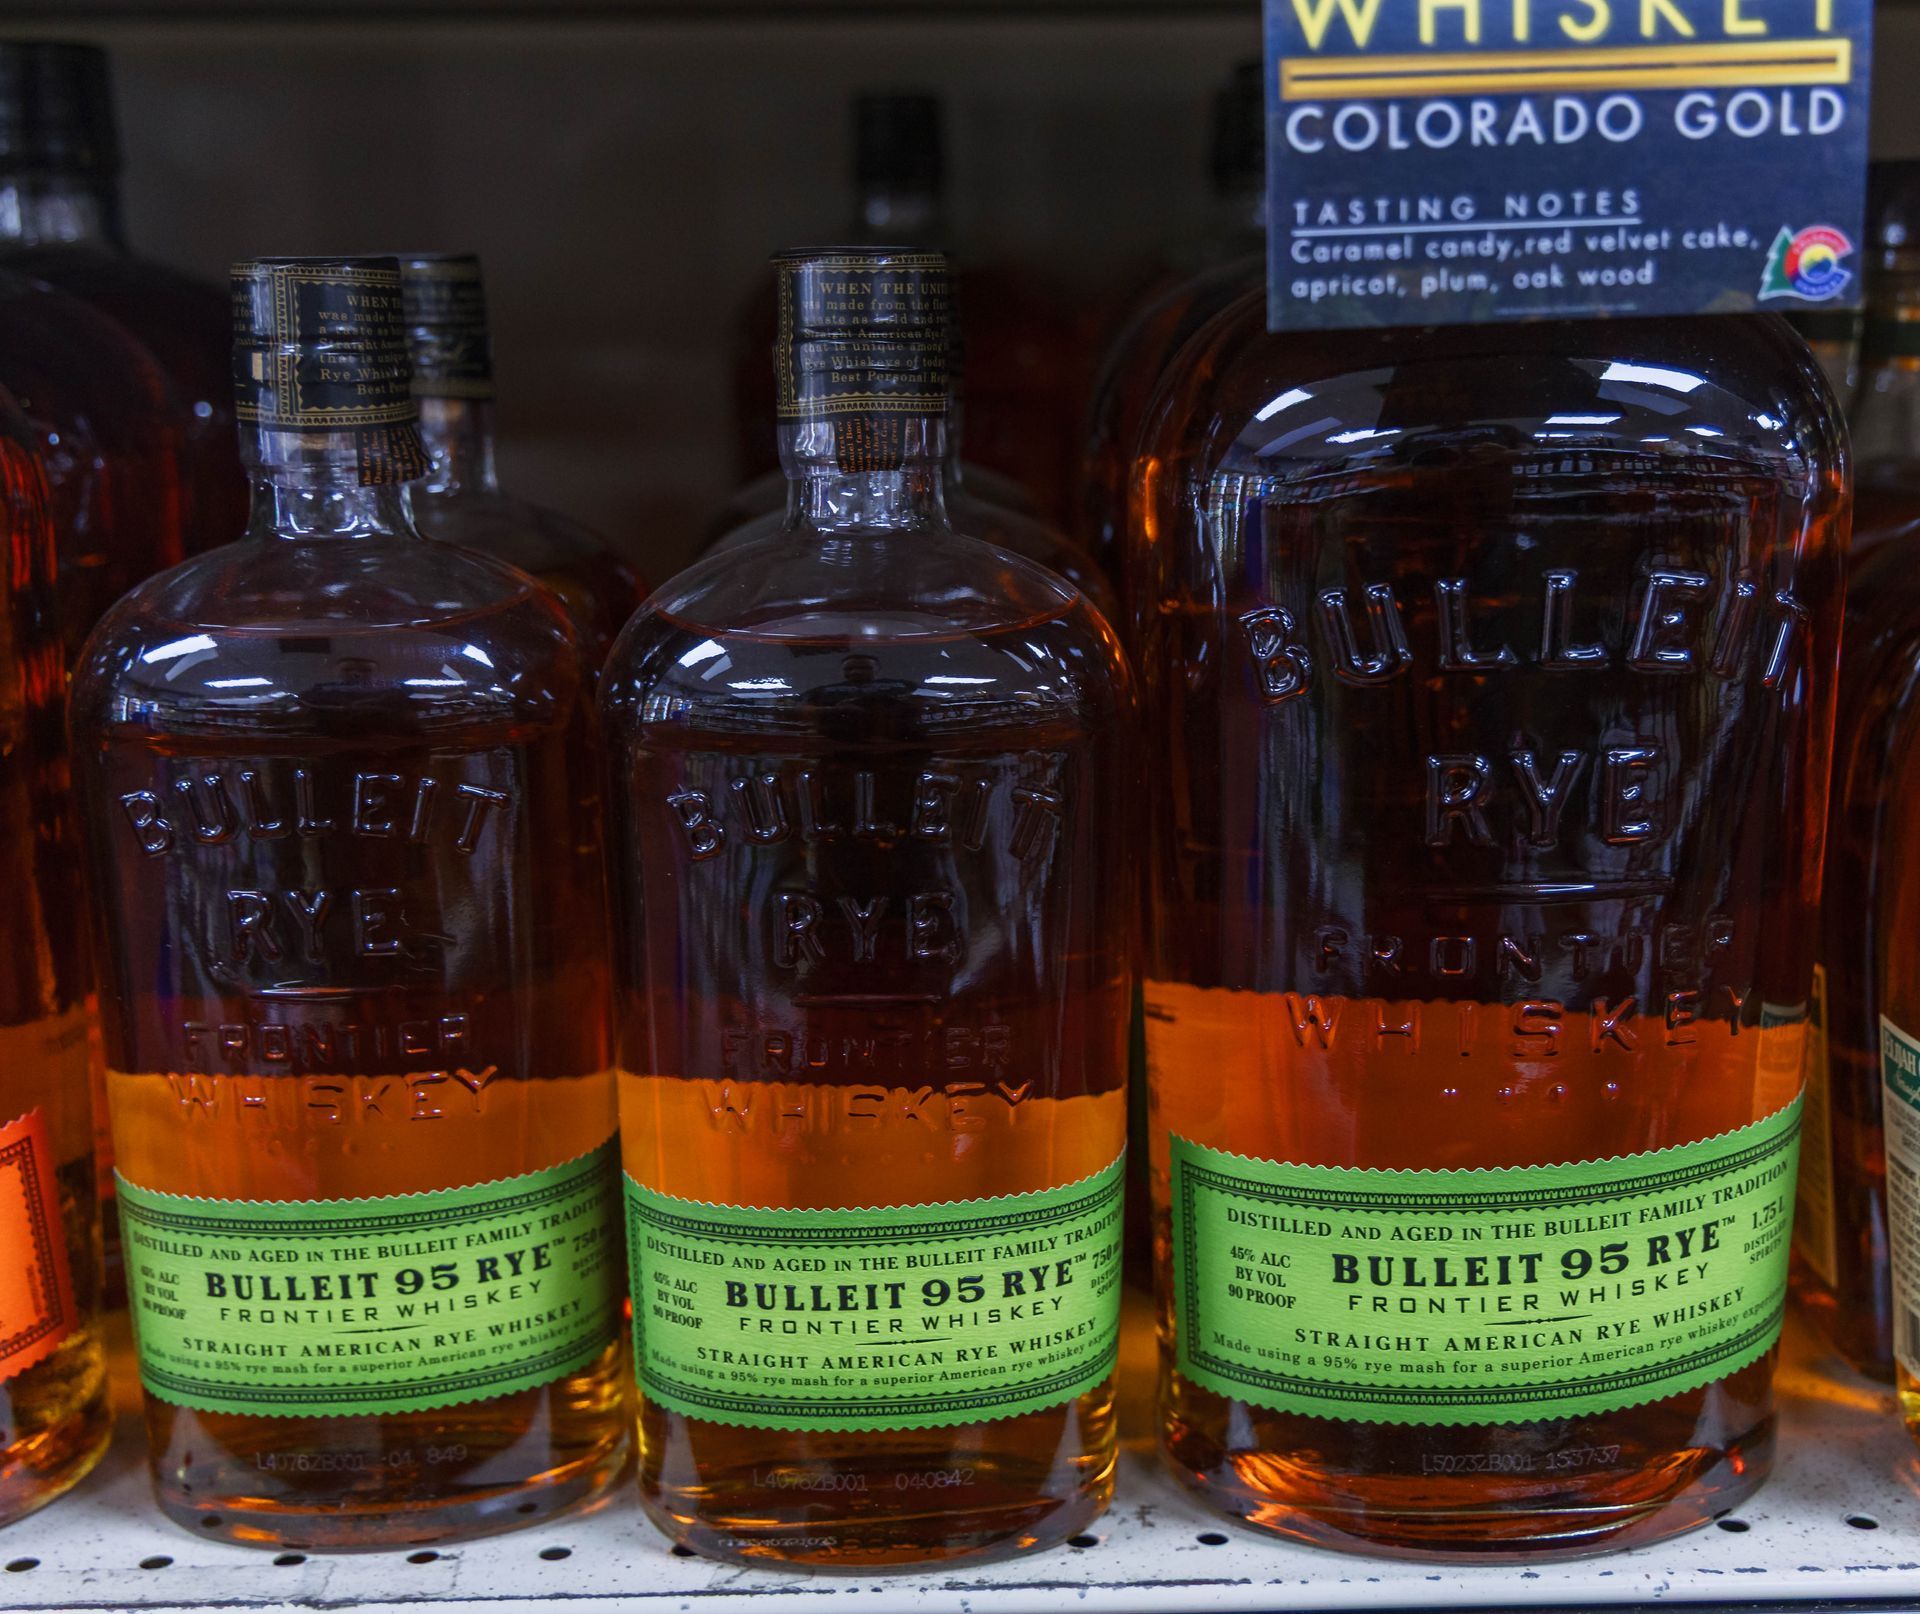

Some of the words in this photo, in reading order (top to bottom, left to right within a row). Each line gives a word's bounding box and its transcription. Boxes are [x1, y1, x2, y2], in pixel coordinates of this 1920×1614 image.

[1285, 95, 1644, 154] COLORADO
[1674, 88, 1846, 140] GOLD
[1294, 196, 1475, 226] TASTING
[1505, 189, 1639, 218] NOTES
[1291, 234, 1412, 264] Caramel
[1585, 226, 1670, 252] velvet
[820, 283, 872, 295] WHEN
[881, 282, 915, 295] THE
[1291, 273, 1407, 303] apricot,
[1513, 262, 1565, 290] oak
[1578, 258, 1656, 286] wood
[346, 295, 389, 308] WHEN
[827, 298, 865, 311] made
[871, 298, 907, 311] from
[320, 368, 352, 382] Rye
[357, 383, 385, 396] Best
[831, 371, 861, 384] Best
[867, 370, 928, 383] Personal
[1237, 567, 1813, 703] BULLEIT
[119, 767, 512, 857] BULLEIT
[665, 769, 1064, 861] BULLEIT
[1423, 744, 1661, 848] RYE
[227, 887, 401, 964] RYE
[772, 892, 964, 969] RYE
[1285, 985, 1751, 1058] WHISKEY
[700, 1078, 1035, 1135] WHISKEY
[1227, 1207, 1332, 1237] DISTILLED
[1341, 1225, 1382, 1241] AND
[1390, 1226, 1453, 1242] AGED
[1462, 1227, 1483, 1241] IN
[1491, 1223, 1536, 1241] THE
[1544, 1211, 1632, 1237] BULLEIT
[1639, 1195, 1707, 1224] FAMILY
[1712, 1159, 1789, 1205] TRADITION
[1751, 1201, 1777, 1230] 1.75
[133, 1231, 203, 1258] DISTILLED
[210, 1249, 241, 1262] AND
[248, 1249, 299, 1263] AGED
[306, 1250, 324, 1262] IN
[330, 1246, 370, 1262] THE
[377, 1237, 459, 1260] BULLEIT
[466, 1222, 533, 1247] FAMILY
[647, 1236, 724, 1266] DISTILLED
[731, 1257, 765, 1270] AND
[773, 1258, 826, 1272] AGED
[834, 1260, 851, 1272] IN
[859, 1256, 898, 1271] THE
[906, 1248, 986, 1269] BULLEIT
[993, 1236, 1059, 1260] FAMILY
[1092, 1245, 1112, 1270] 750
[1230, 1244, 1256, 1263] 45%
[1260, 1251, 1291, 1269] ALC
[159, 1271, 180, 1285] ALC
[205, 1271, 379, 1301] BULLEIT
[395, 1262, 460, 1295] 95
[1235, 1266, 1253, 1282] BY
[1257, 1271, 1287, 1288] VOL
[1332, 1253, 1542, 1287] BULLEIT
[1560, 1240, 1630, 1280] 95
[158, 1287, 179, 1301] VOL
[220, 1306, 378, 1323] FRONTIER
[396, 1279, 542, 1318] WHISKEY
[657, 1289, 669, 1301] BY
[671, 1294, 695, 1311] VOL
[674, 1278, 698, 1294] ALC
[725, 1280, 906, 1311] BULLEIT
[921, 1273, 985, 1307] 95
[1228, 1283, 1244, 1299] 90
[1246, 1288, 1297, 1310] PROOF
[1348, 1294, 1539, 1314] FRONTIER
[1560, 1262, 1709, 1308] WHISKEY
[153, 1303, 187, 1320] PROOF
[183, 1337, 288, 1357] STRAIGHT
[300, 1338, 421, 1357] AMERICAN
[434, 1329, 477, 1348] RYE
[488, 1298, 581, 1337] WHISKEY
[665, 1310, 703, 1329] PROOF
[740, 1317, 903, 1335] FRONTIER
[921, 1295, 1063, 1331] WHISKEY
[1295, 1328, 1430, 1352] STRAIGHT
[1444, 1328, 1583, 1352] AMERICAN
[1596, 1319, 1641, 1341] RYE
[1653, 1287, 1745, 1329] WHISKEY
[215, 1358, 240, 1371] 95%
[246, 1364, 267, 1375] rye
[272, 1363, 308, 1374] mash
[313, 1362, 333, 1374] for
[352, 1357, 413, 1374] superior
[418, 1347, 486, 1368] American
[491, 1341, 513, 1356] rye
[518, 1325, 570, 1349] whiskey
[697, 1347, 809, 1369] STRAIGHT
[821, 1351, 944, 1370] AMERICAN
[956, 1345, 998, 1363] RYE
[1009, 1317, 1097, 1355] WHISKEY
[1213, 1331, 1250, 1354] Made
[1257, 1347, 1300, 1366] using
[1307, 1356, 1316, 1367] a
[1323, 1356, 1358, 1370] 95%
[1364, 1361, 1393, 1374] rye
[1400, 1360, 1446, 1374] mash
[1453, 1360, 1477, 1374] for
[1484, 1363, 1494, 1373] a
[1501, 1356, 1574, 1373] superior
[1579, 1341, 1655, 1365] American
[1660, 1334, 1683, 1350] rye
[1687, 1313, 1740, 1338] whiskey
[651, 1349, 677, 1366] Made
[680, 1362, 714, 1380] using
[718, 1371, 726, 1380] a
[730, 1370, 758, 1383] 95%
[763, 1375, 786, 1387] rye
[791, 1374, 828, 1387] mash
[834, 1374, 855, 1386] for
[859, 1377, 867, 1386] a
[873, 1371, 933, 1387] superior
[939, 1364, 1007, 1382] American
[1012, 1360, 1033, 1373] rye
[1038, 1345, 1085, 1367] whiskey
